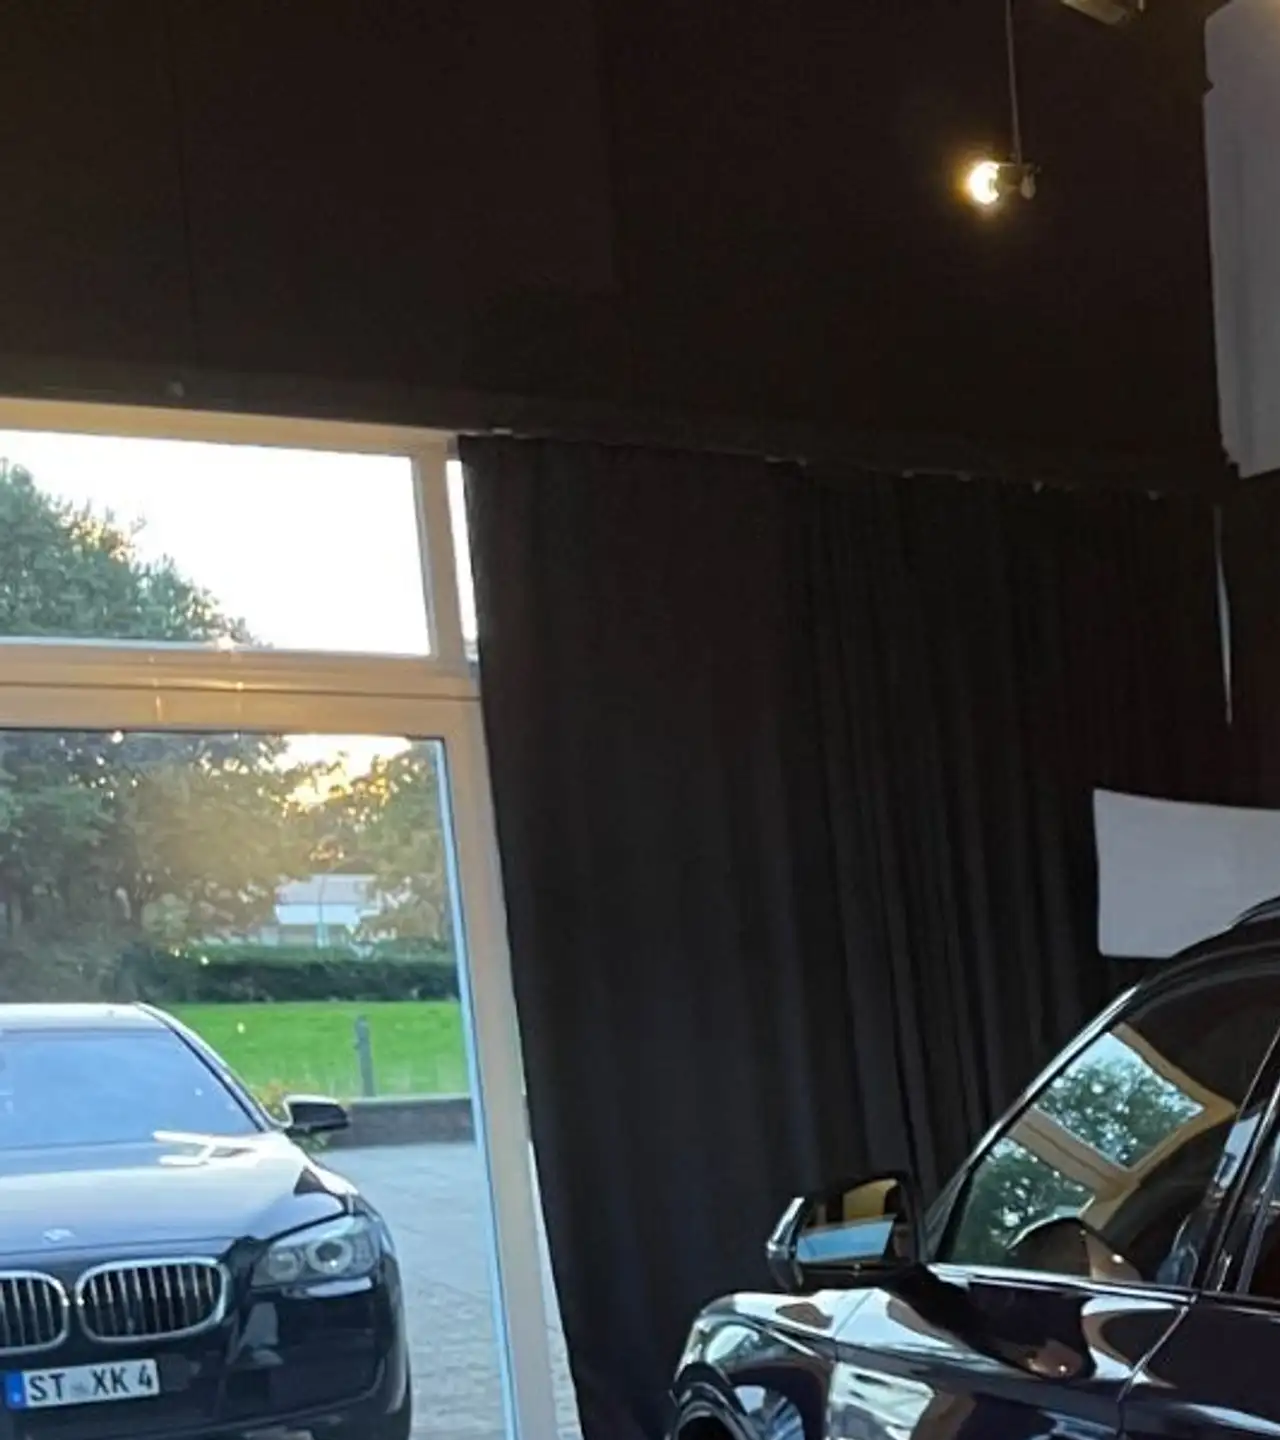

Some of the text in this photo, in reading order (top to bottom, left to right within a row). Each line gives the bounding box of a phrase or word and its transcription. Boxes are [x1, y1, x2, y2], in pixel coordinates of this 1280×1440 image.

[29, 1364, 153, 1402] ST XK 4
